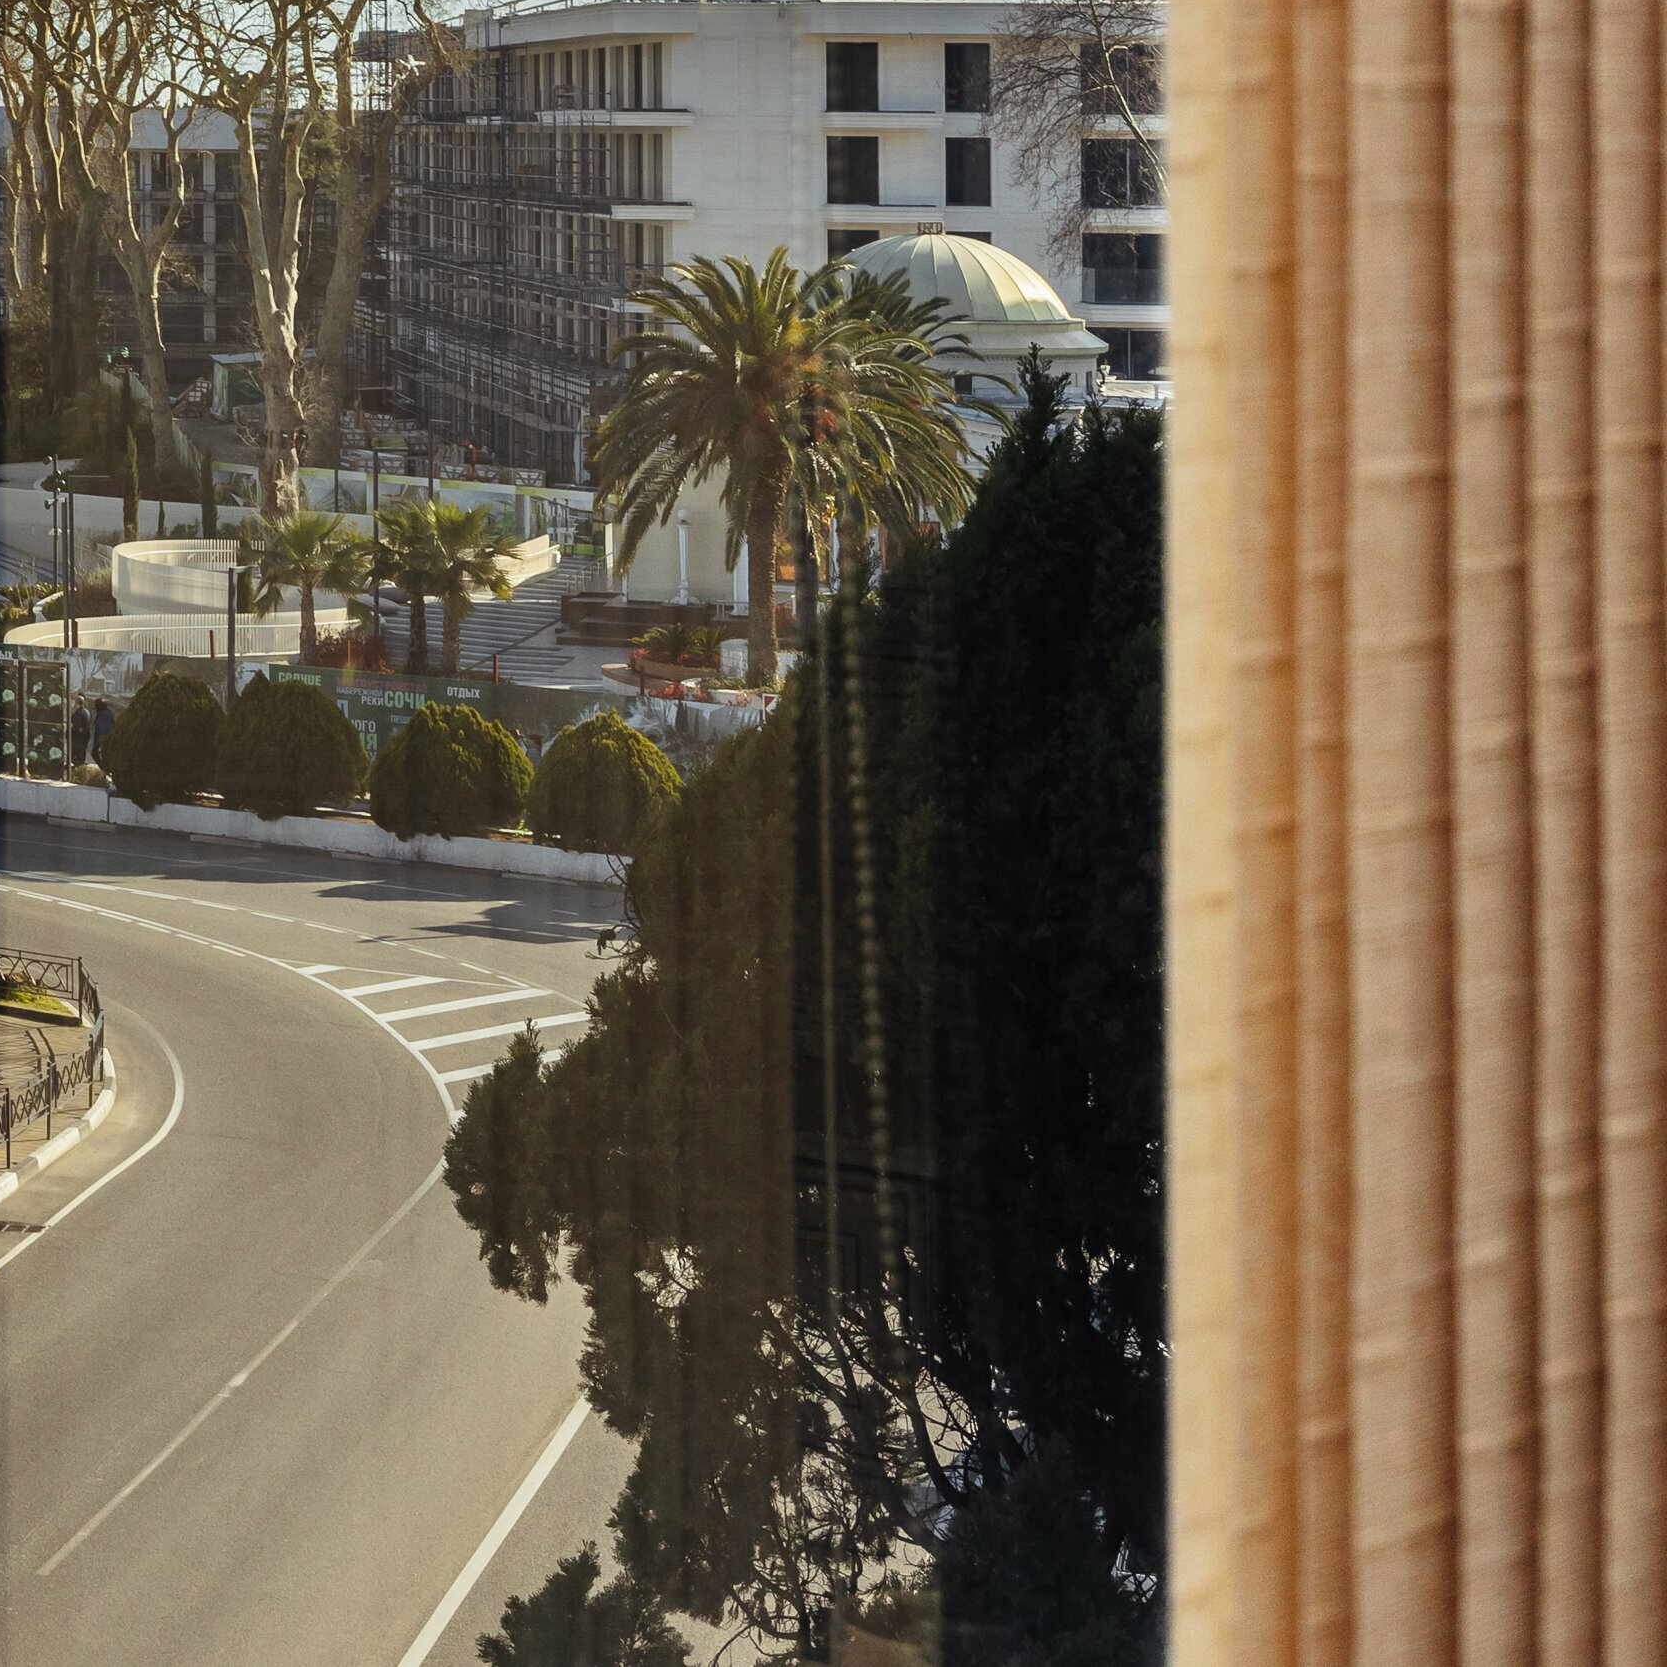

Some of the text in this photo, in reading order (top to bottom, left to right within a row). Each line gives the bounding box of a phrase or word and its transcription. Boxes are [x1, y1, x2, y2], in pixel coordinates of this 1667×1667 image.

[361, 690, 425, 709] РЕКИ СОЧИ
[446, 686, 481, 699] ОТДЫХ
